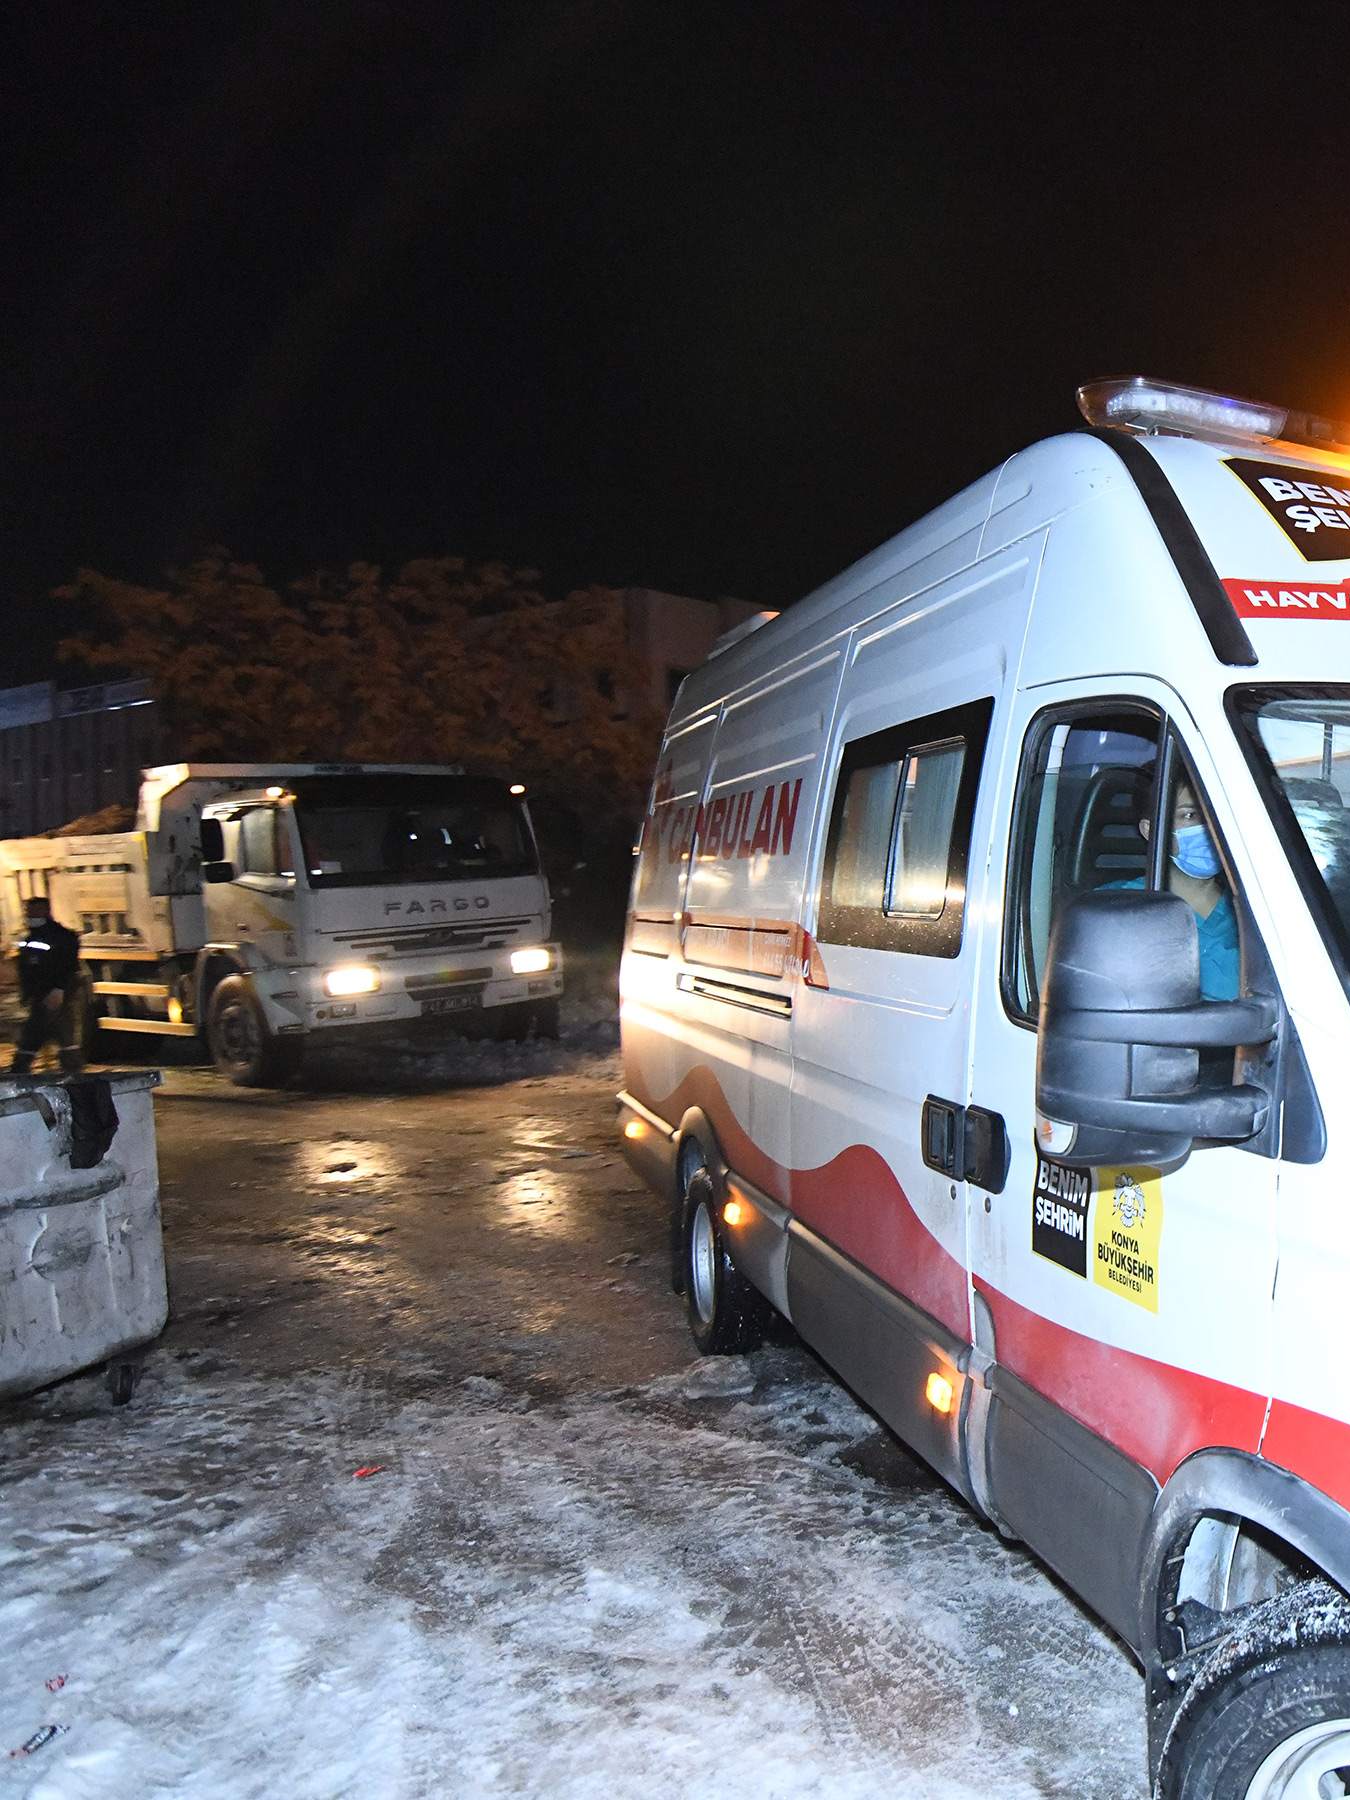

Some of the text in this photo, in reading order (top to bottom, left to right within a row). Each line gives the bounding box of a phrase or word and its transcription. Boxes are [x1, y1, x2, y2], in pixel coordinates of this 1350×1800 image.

[385, 896, 490, 916] FARGO
[1037, 1159, 1089, 1207] BENİM
[1035, 1196, 1084, 1241] ŞEHRİM
[1111, 1230, 1140, 1255] KONYA
[1097, 1242, 1154, 1284] BÜYÜKŞEHİR
[1108, 1268, 1142, 1293] BELEDİYESİ
